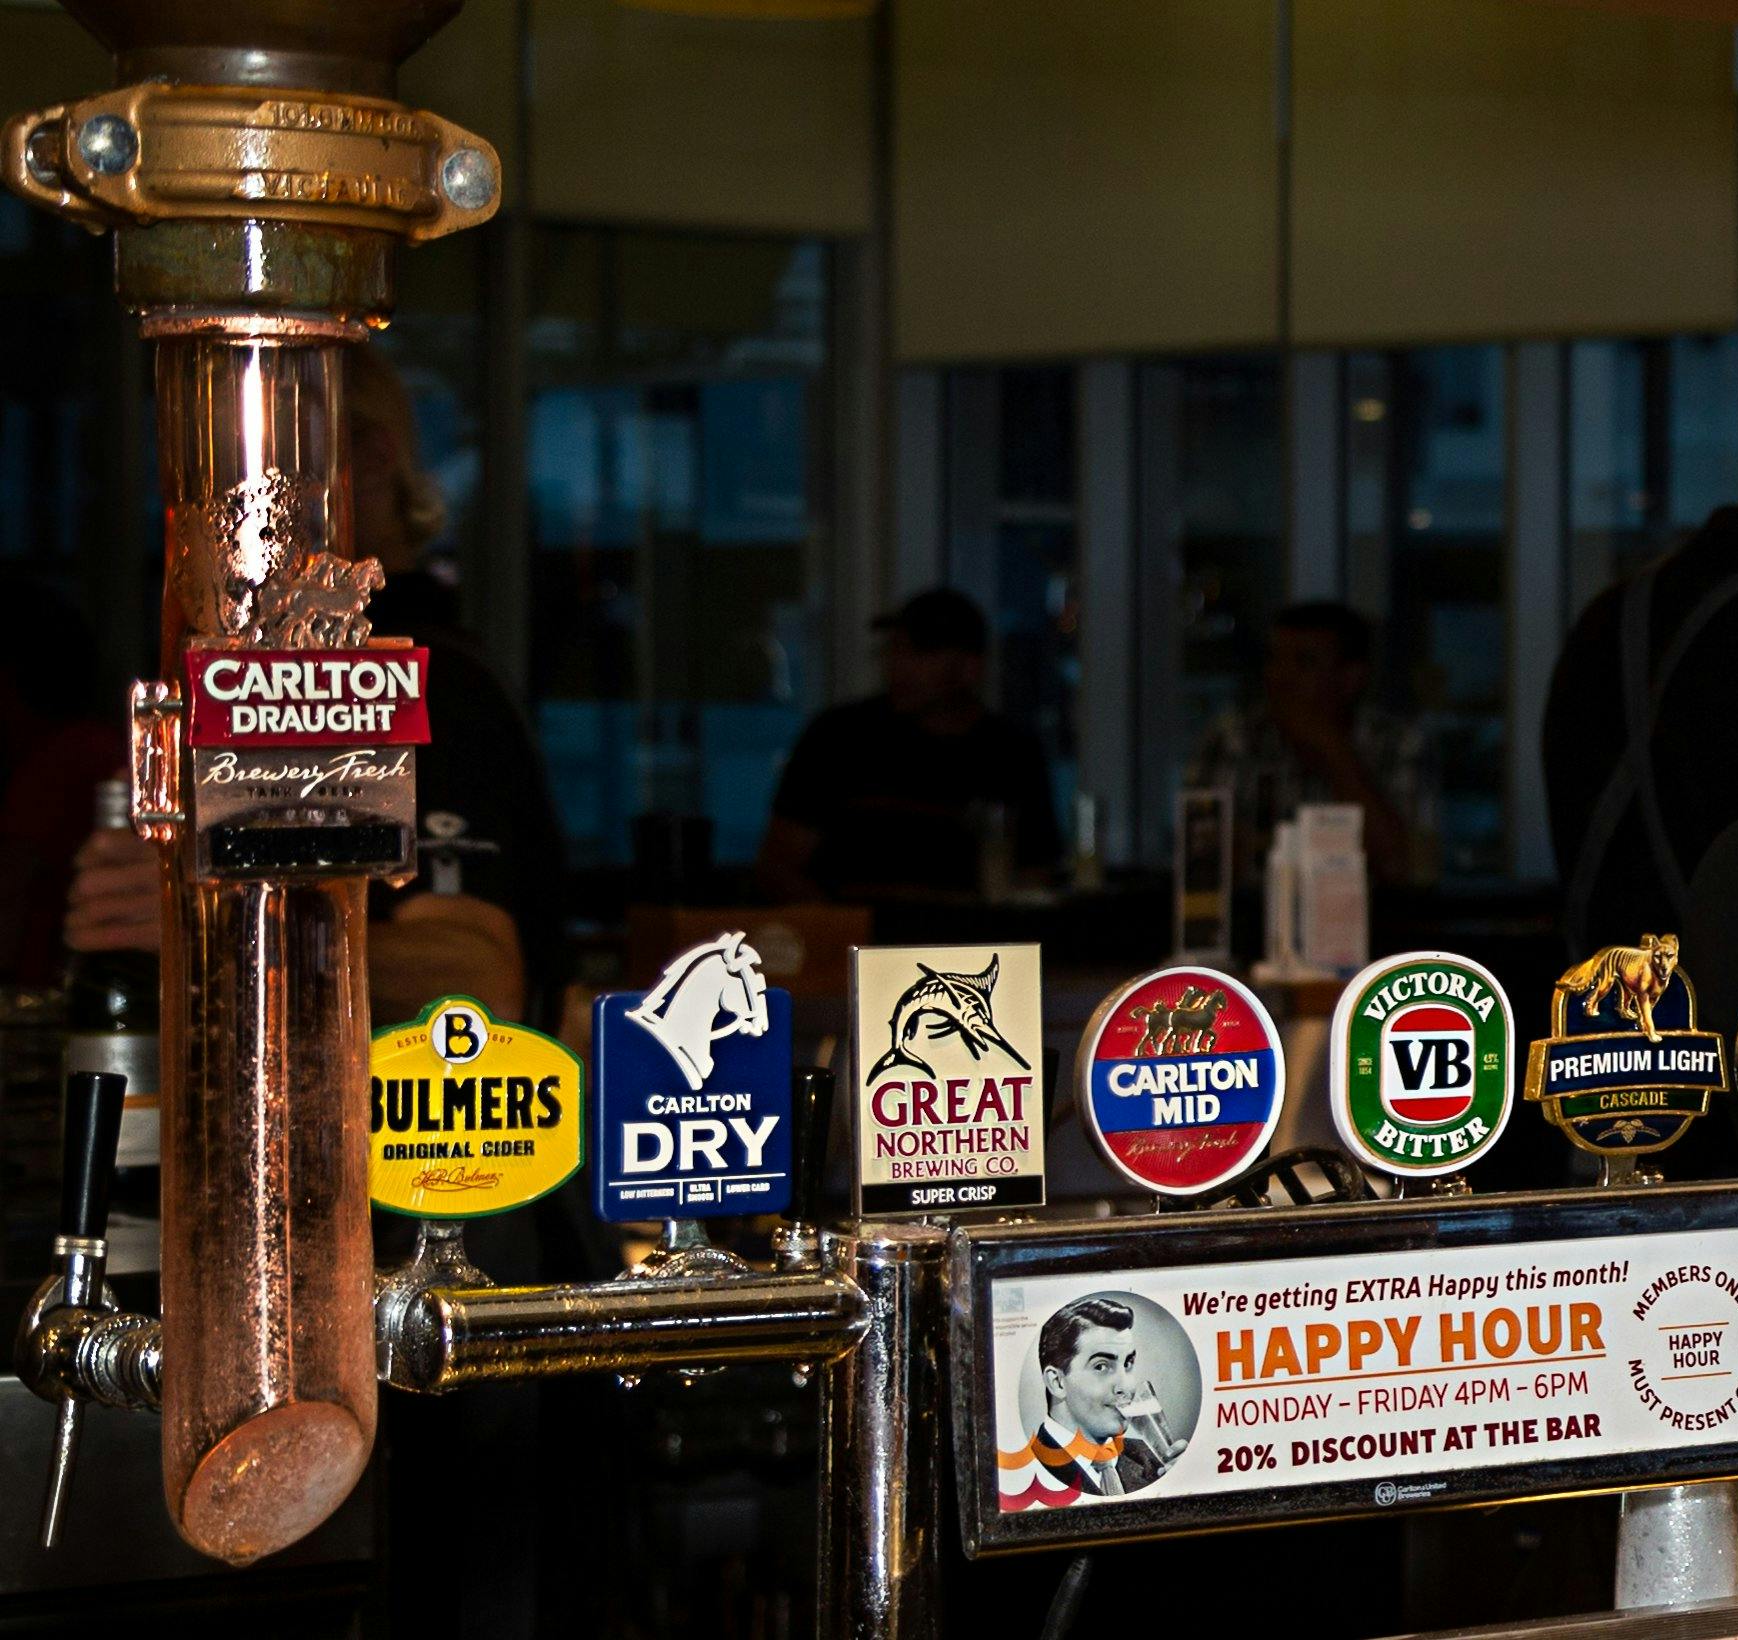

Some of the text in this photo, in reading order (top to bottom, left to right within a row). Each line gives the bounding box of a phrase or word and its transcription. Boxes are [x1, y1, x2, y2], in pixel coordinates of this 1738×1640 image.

[204, 659, 419, 701] CARLTON
[233, 705, 396, 733] DRAUGHT
[201, 750, 410, 798] Brewery Fresh
[1362, 971, 1497, 1023] VICTORIA
[396, 1034, 427, 1048] ESTD
[445, 1014, 479, 1058] B
[1108, 1058, 1259, 1097] CARLTON
[1389, 1038, 1472, 1091] VB
[1550, 1050, 1718, 1082] PREMIUM LIGHT
[647, 1094, 751, 1115] CARLTON
[871, 1077, 1033, 1128] GREAT
[1153, 1094, 1221, 1125] MID
[1600, 1091, 1668, 1110] CASCADE
[383, 1140, 535, 1160] ORIGINAL CIDER
[622, 1116, 780, 1173] DRY
[876, 1126, 1029, 1158] NORTHERN
[1373, 1116, 1490, 1158] BITTER
[892, 1159, 978, 1179] BREWING
[912, 1186, 997, 1205] SUPER CRISP
[1183, 1261, 1628, 1316] We're getting EXTRA Happy this month!
[1632, 1265, 1712, 1321] MEMBERS
[1217, 1302, 1606, 1382] HAPPY HOUR
[1669, 1331, 1723, 1350] HAPPY
[1673, 1350, 1720, 1368] HOUR
[1217, 1394, 1333, 1428] MONDAY
[1358, 1384, 1449, 1415] FRIDAY
[1455, 1379, 1510, 1406] 4PM
[1534, 1371, 1589, 1399] 6PM
[1628, 1359, 1662, 1411] MUST
[1659, 1397, 1737, 1431] PRESENT
[1217, 1413, 1602, 1474] 20% DISCOUNT AT THE BAR
